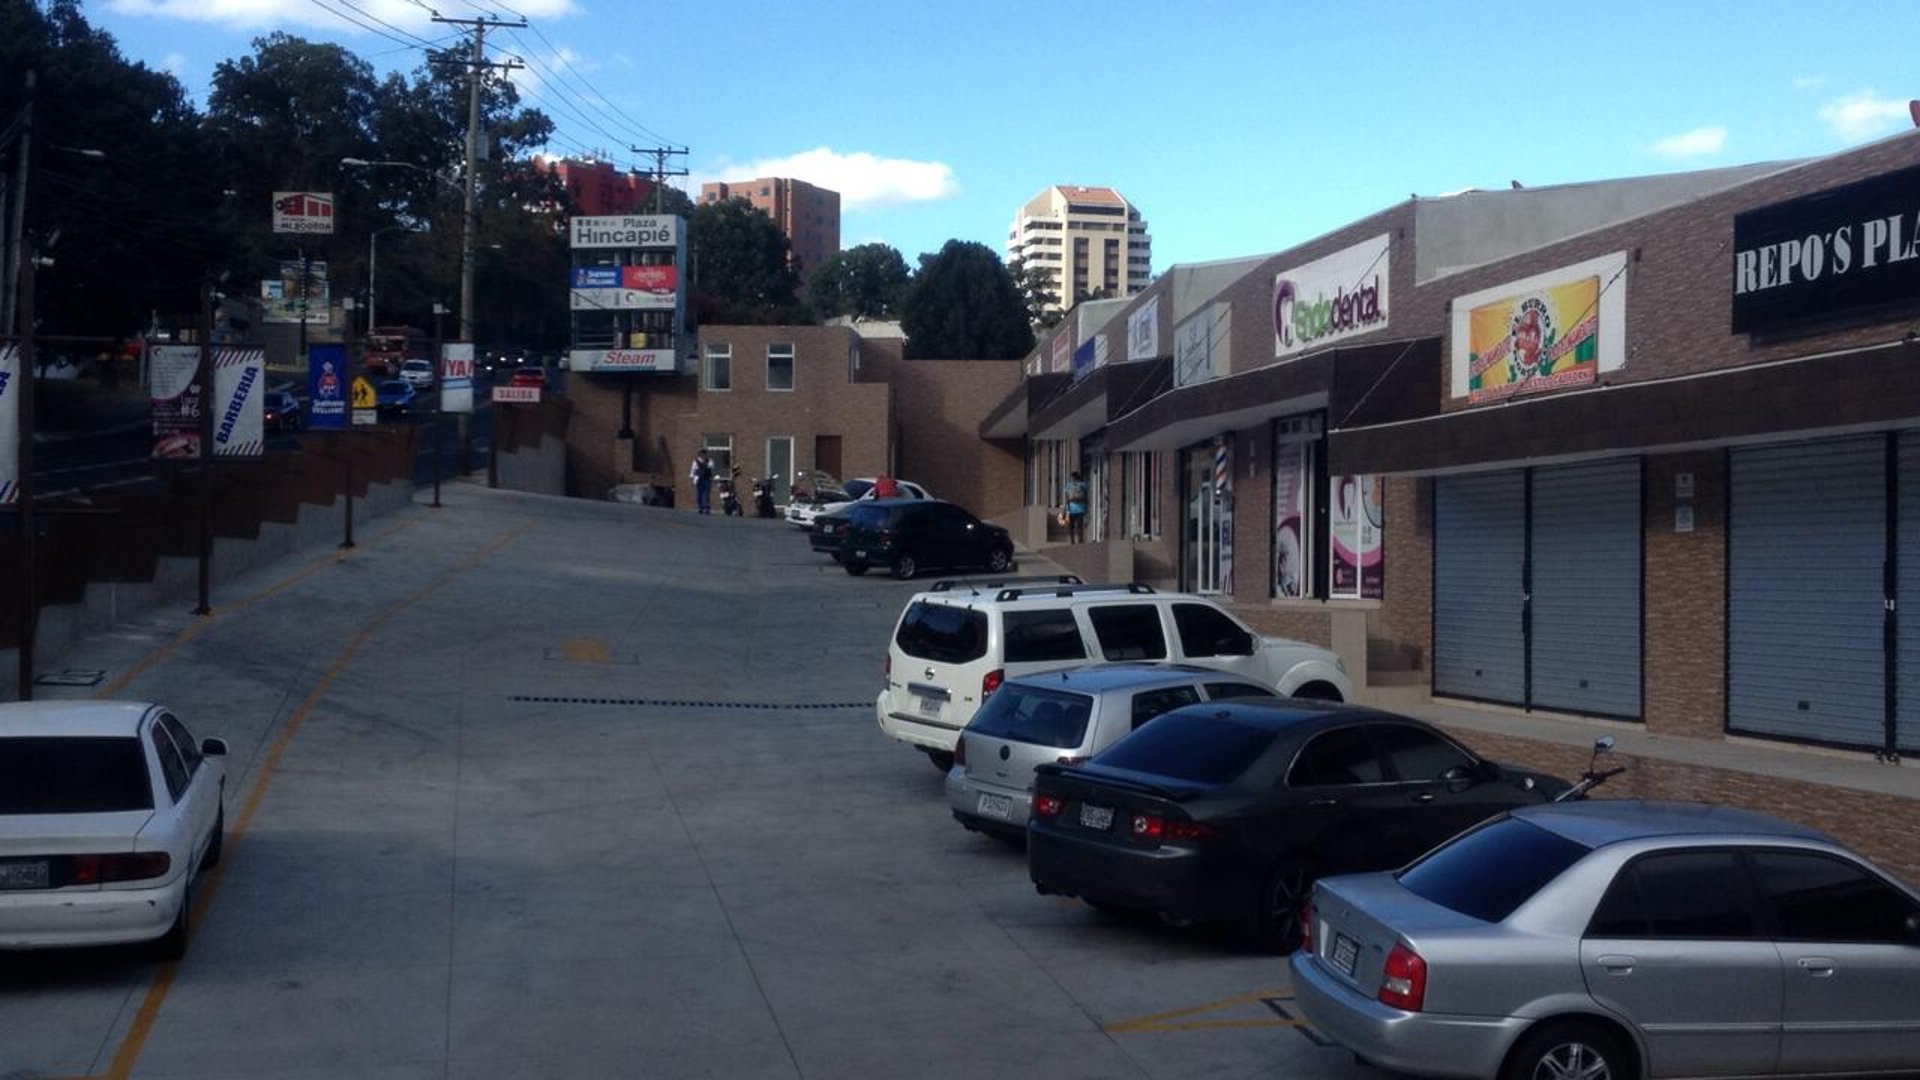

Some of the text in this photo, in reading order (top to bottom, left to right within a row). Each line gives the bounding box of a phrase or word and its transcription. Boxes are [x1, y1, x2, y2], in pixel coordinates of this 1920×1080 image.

[623, 218, 657, 228] Plaza
[576, 225, 670, 245] Hincapié
[604, 350, 656, 365] Steam
[214, 365, 260, 445] BARBERIA
